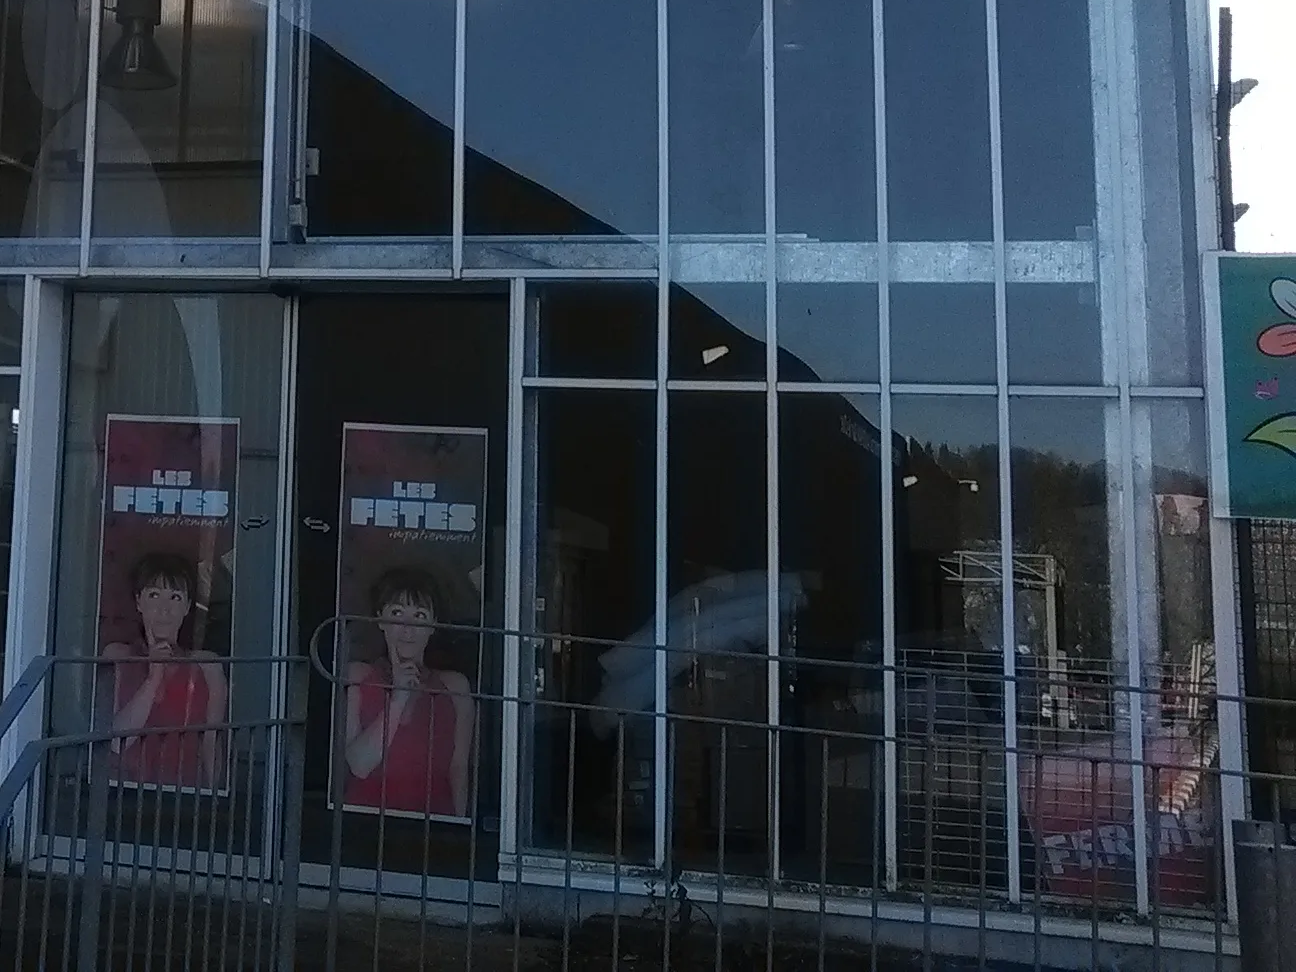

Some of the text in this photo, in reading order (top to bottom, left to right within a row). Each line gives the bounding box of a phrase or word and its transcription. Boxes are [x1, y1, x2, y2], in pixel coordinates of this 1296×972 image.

[151, 468, 193, 487] LES
[392, 480, 437, 500] LES
[112, 485, 230, 518] FETES
[350, 496, 478, 533] FETES
